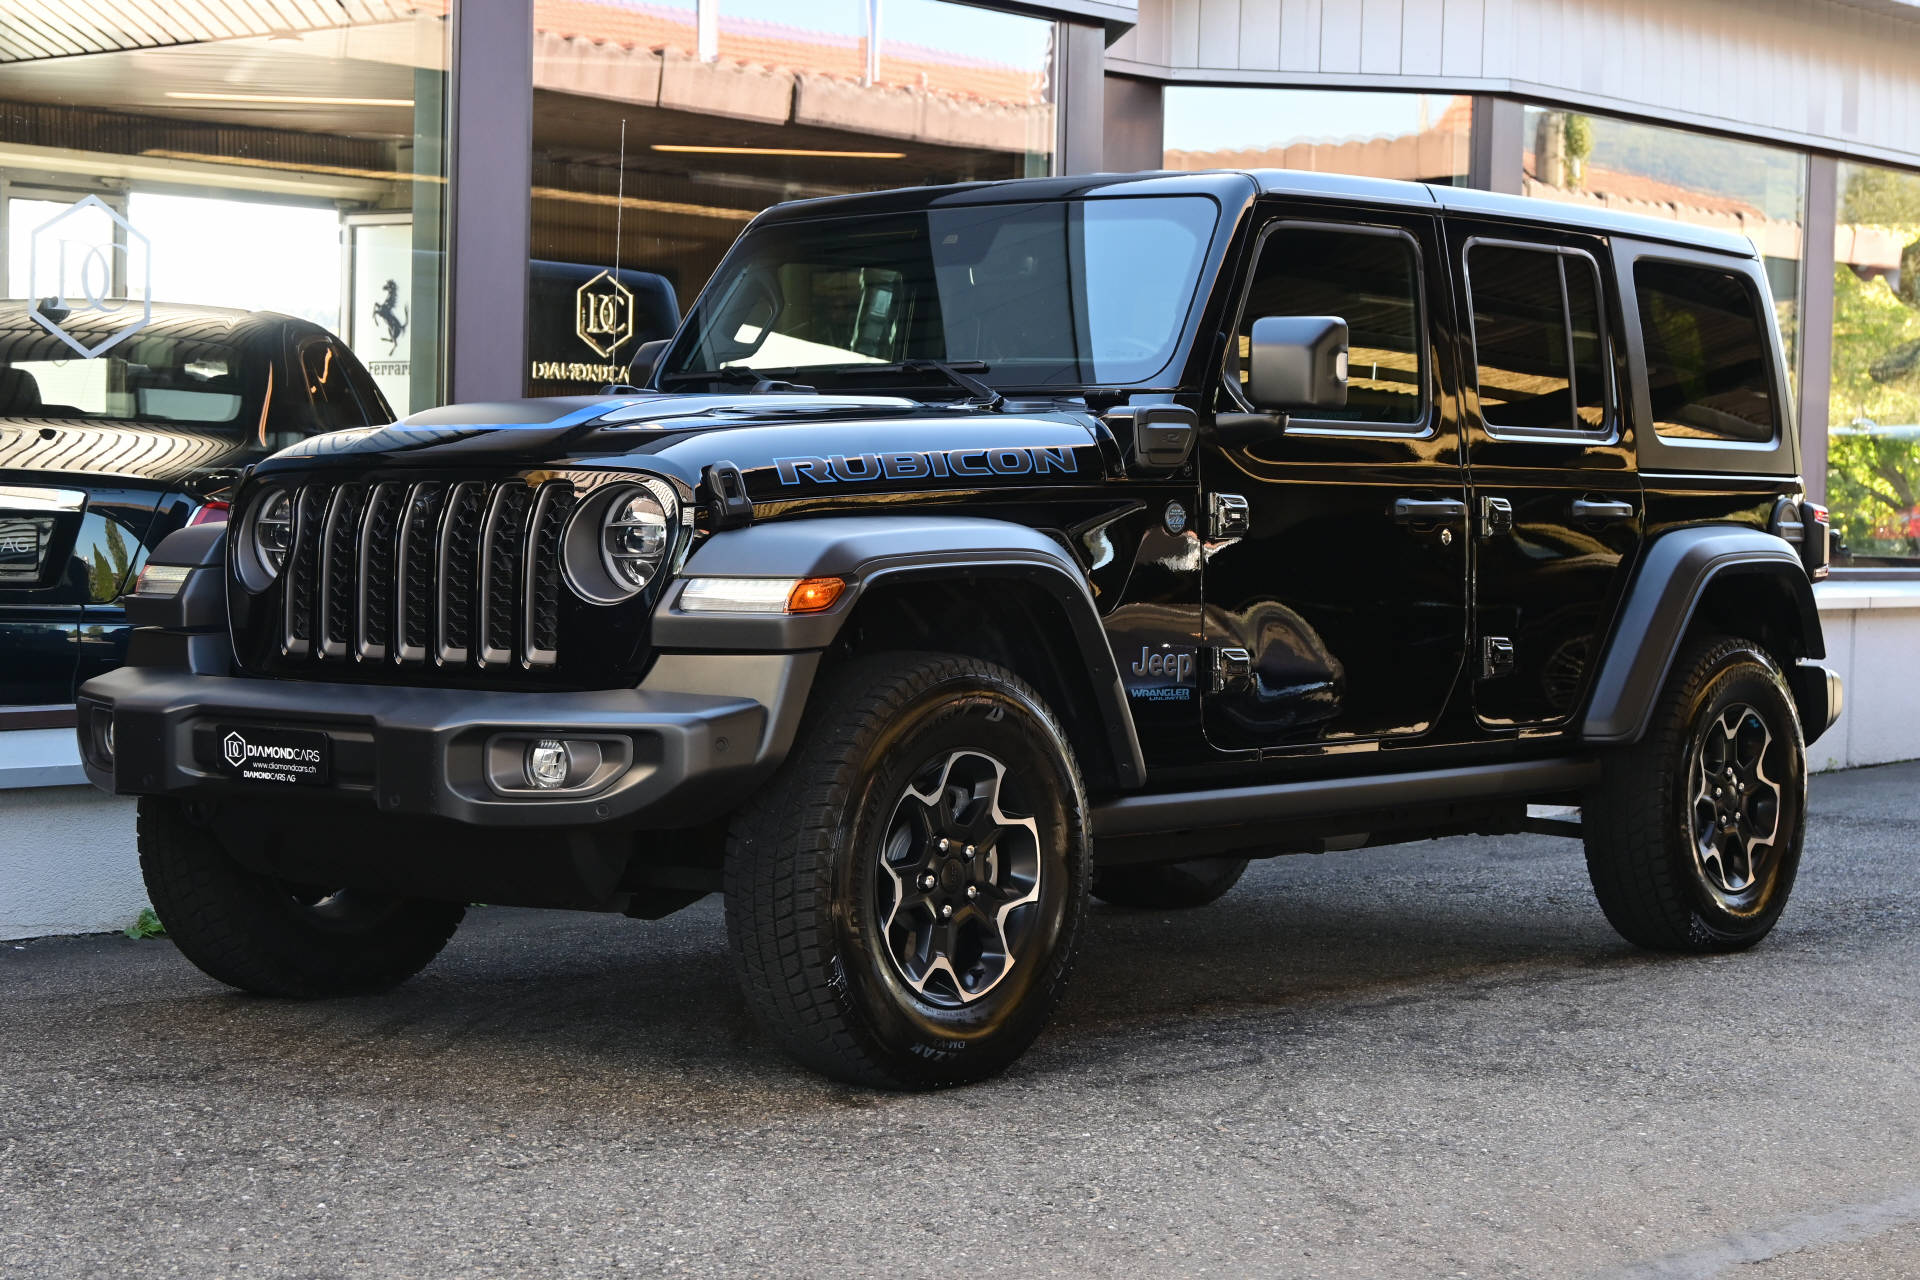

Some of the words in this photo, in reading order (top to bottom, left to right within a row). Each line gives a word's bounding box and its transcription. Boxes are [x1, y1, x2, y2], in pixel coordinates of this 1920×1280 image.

[587, 293, 625, 334] DC
[772, 447, 1078, 485] RUBICON
[0, 537, 29, 553] AG
[1132, 646, 1193, 683] Jeep
[1131, 689, 1189, 698] WRANGLER
[228, 741, 242, 757] DC
[247, 744, 320, 762] DIAMONDCARS
[253, 762, 316, 773] www.diamondcars.ch
[243, 771, 286, 782] DIAMONDCARS
